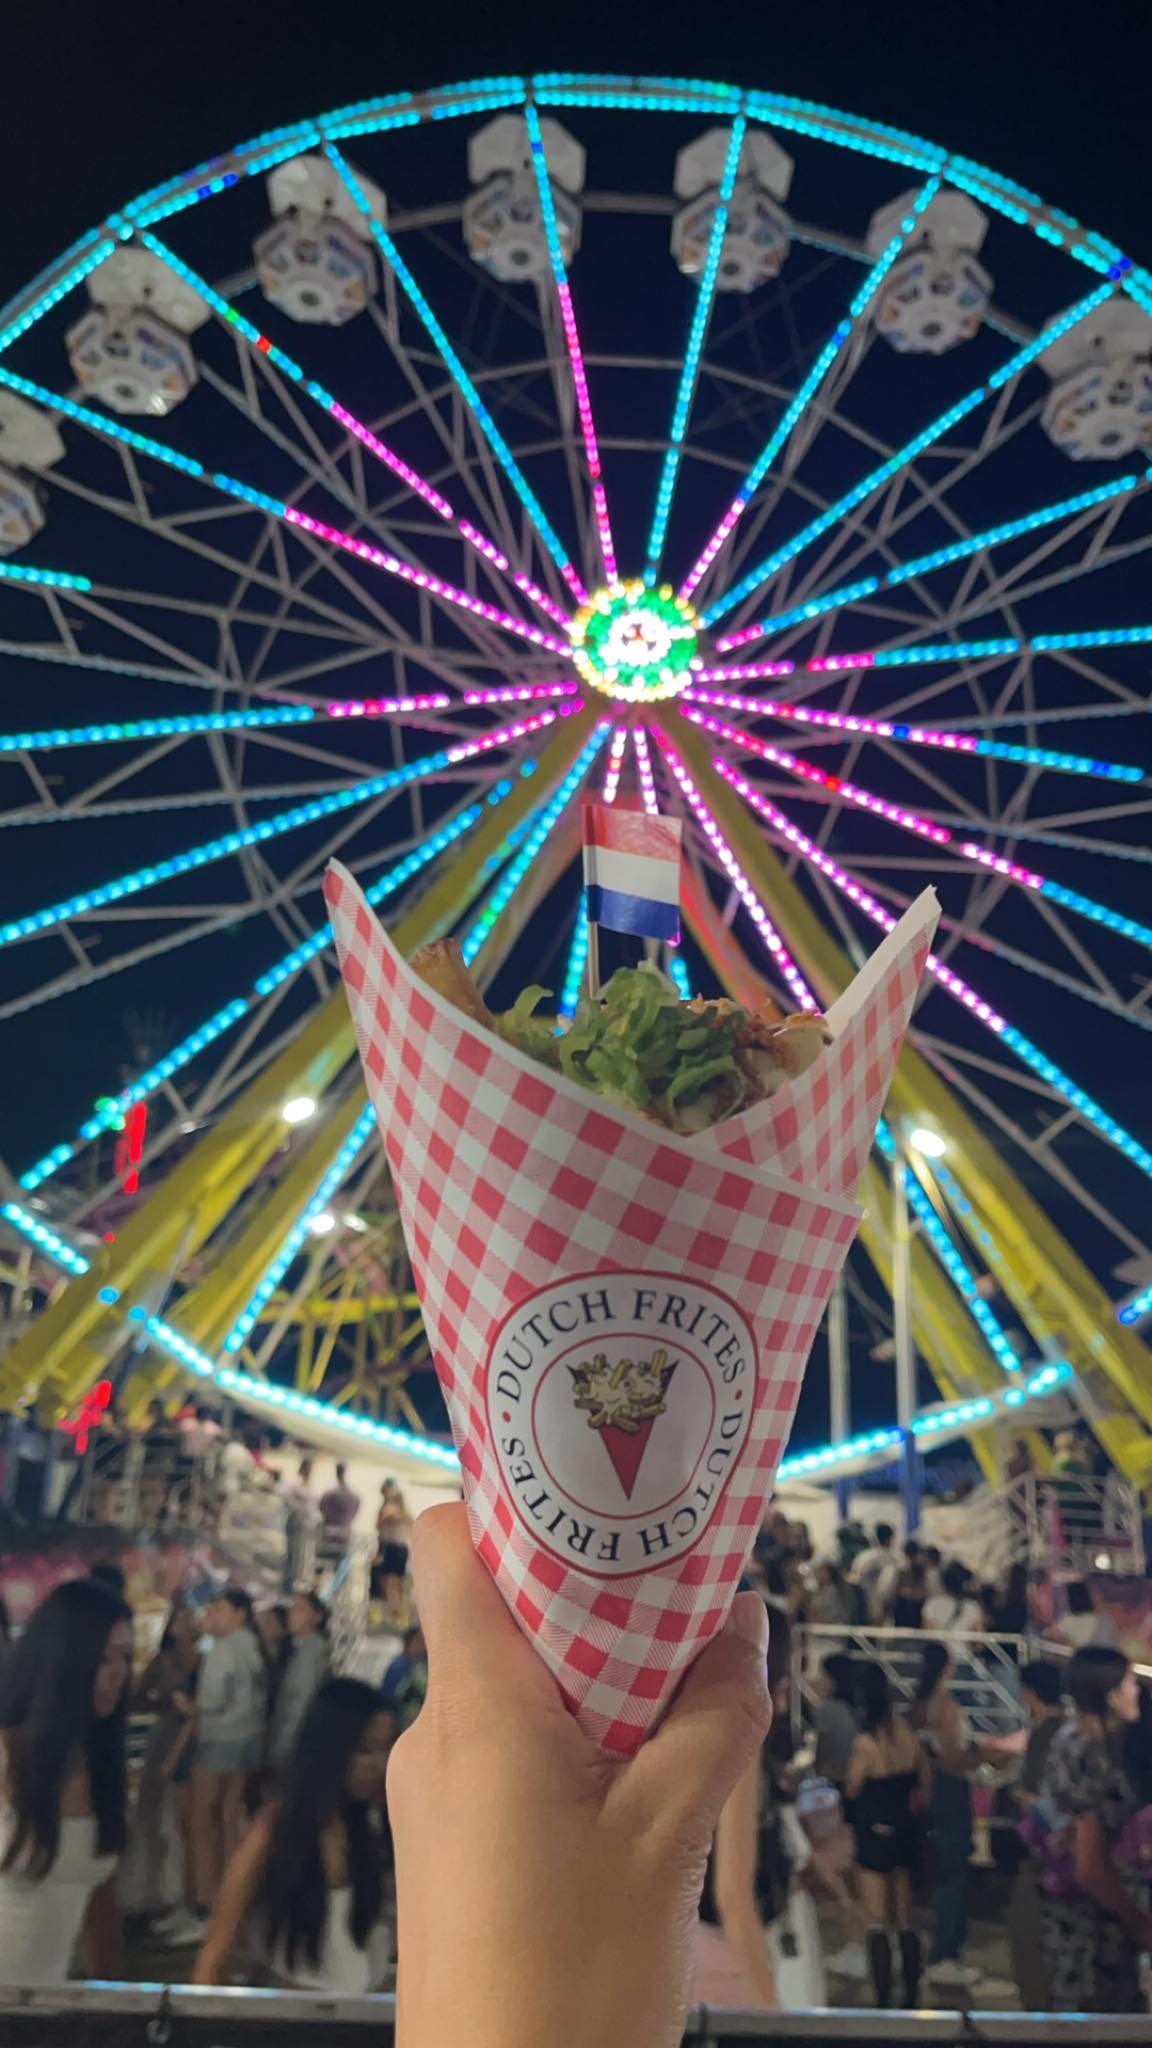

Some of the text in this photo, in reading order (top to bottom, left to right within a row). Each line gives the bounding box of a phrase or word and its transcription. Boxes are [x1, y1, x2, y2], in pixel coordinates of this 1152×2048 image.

[497, 1289, 745, 1403] DUTCH FRITES
[501, 1409, 744, 1561] DUTCH FRITES
